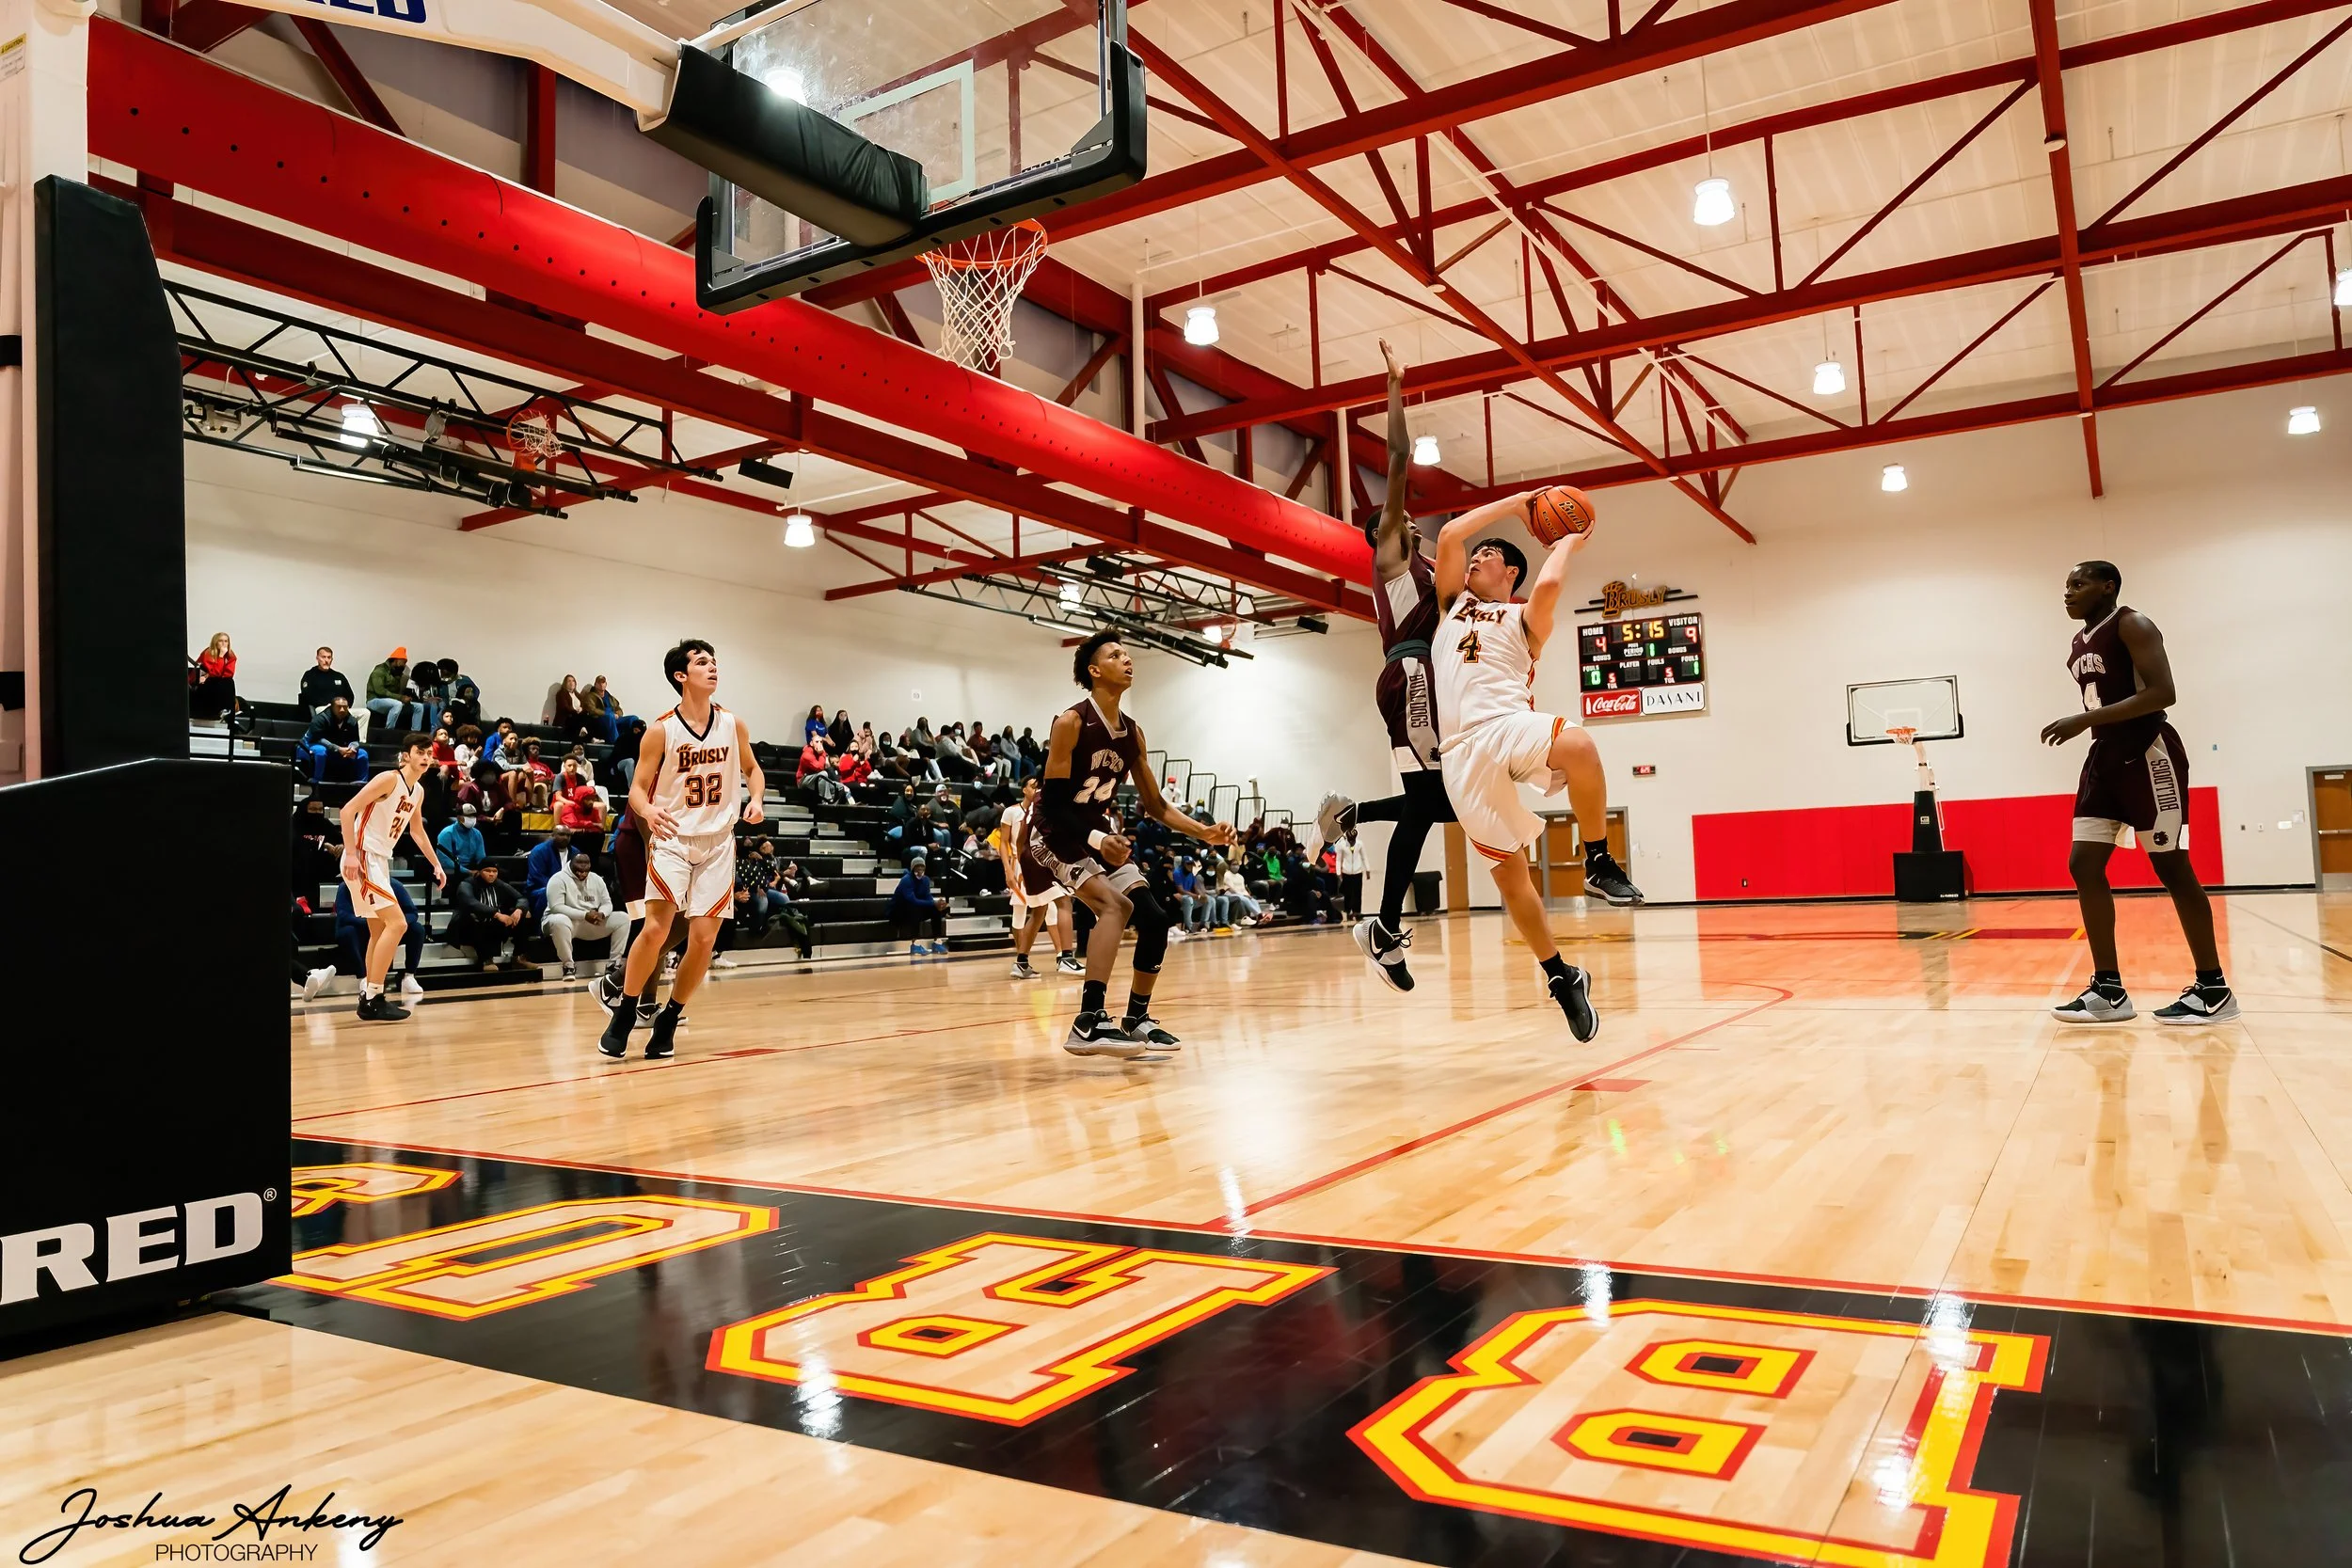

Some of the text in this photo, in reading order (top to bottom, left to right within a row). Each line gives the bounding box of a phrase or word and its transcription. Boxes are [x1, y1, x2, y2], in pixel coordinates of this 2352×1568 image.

[1558, 500, 1585, 532] Bade
[1602, 581, 1667, 618] BRUSLY
[1582, 626, 1604, 637] HOME
[1622, 620, 1664, 641] 5:15
[1668, 616, 1698, 626] VISITOR
[1456, 629, 1482, 663] 4
[1596, 636, 1607, 653] 4
[1685, 626, 1697, 643] 9
[1409, 673, 1428, 728] BULLDOGS
[1592, 694, 1639, 713] Coca-Cola
[1647, 691, 1700, 706] DASANI
[676, 743, 729, 773] BRUSLY
[684, 772, 723, 808] 32
[2151, 758, 2180, 812] BULLDOGS
